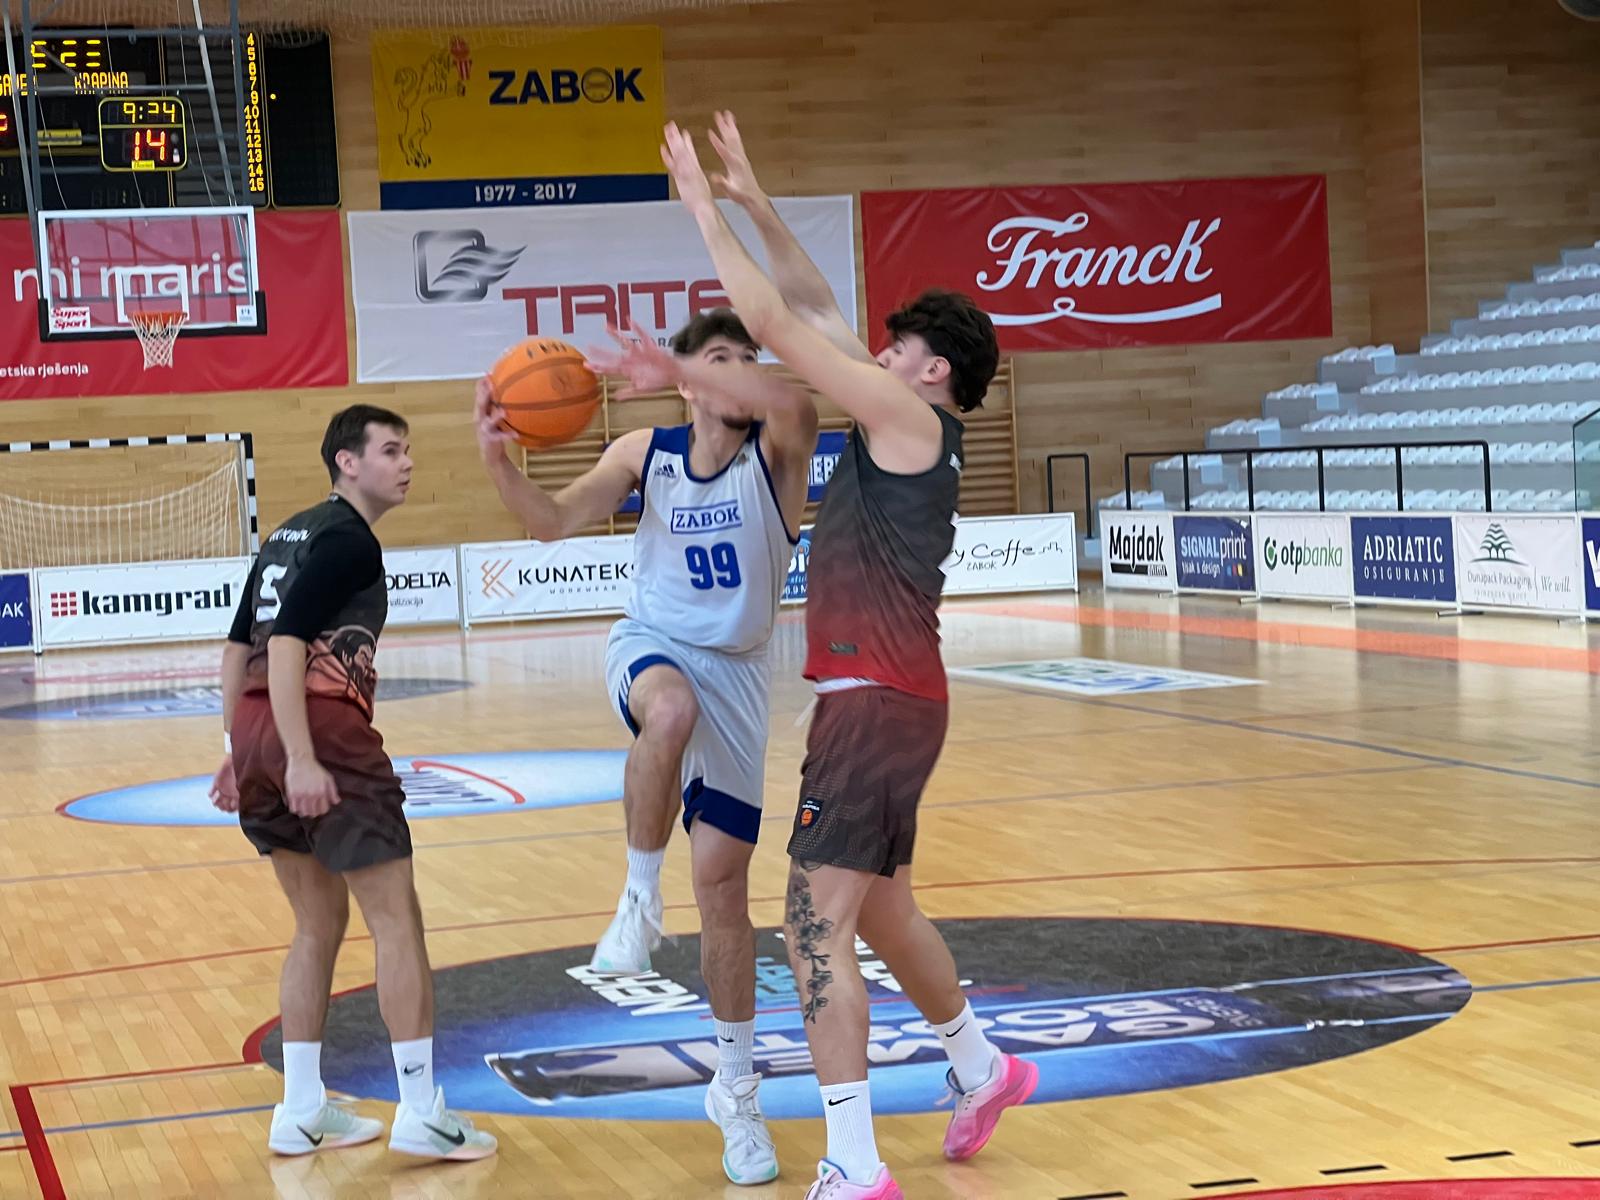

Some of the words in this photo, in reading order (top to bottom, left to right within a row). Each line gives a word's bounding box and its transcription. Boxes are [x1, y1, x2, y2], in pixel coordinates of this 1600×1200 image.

[247, 47, 256, 61] 5
[249, 76, 257, 91] 7
[489, 67, 646, 106] ZABOK
[244, 105, 260, 119] 10
[245, 119, 260, 133] 11
[134, 129, 166, 161] 14
[246, 134, 262, 148] 12
[247, 148, 263, 163] 13
[473, 184, 517, 202] 1977
[534, 182, 578, 200] 2017
[976, 212, 1221, 292] Franck
[675, 505, 741, 529] ZABOK
[1109, 525, 1164, 565] Majdak
[1363, 534, 1444, 563] ADRIATIC
[518, 562, 634, 586] KUNATEK
[685, 541, 742, 591] 99
[1363, 565, 1446, 586] OSIGURANJE
[82, 583, 231, 617] kamgrad
